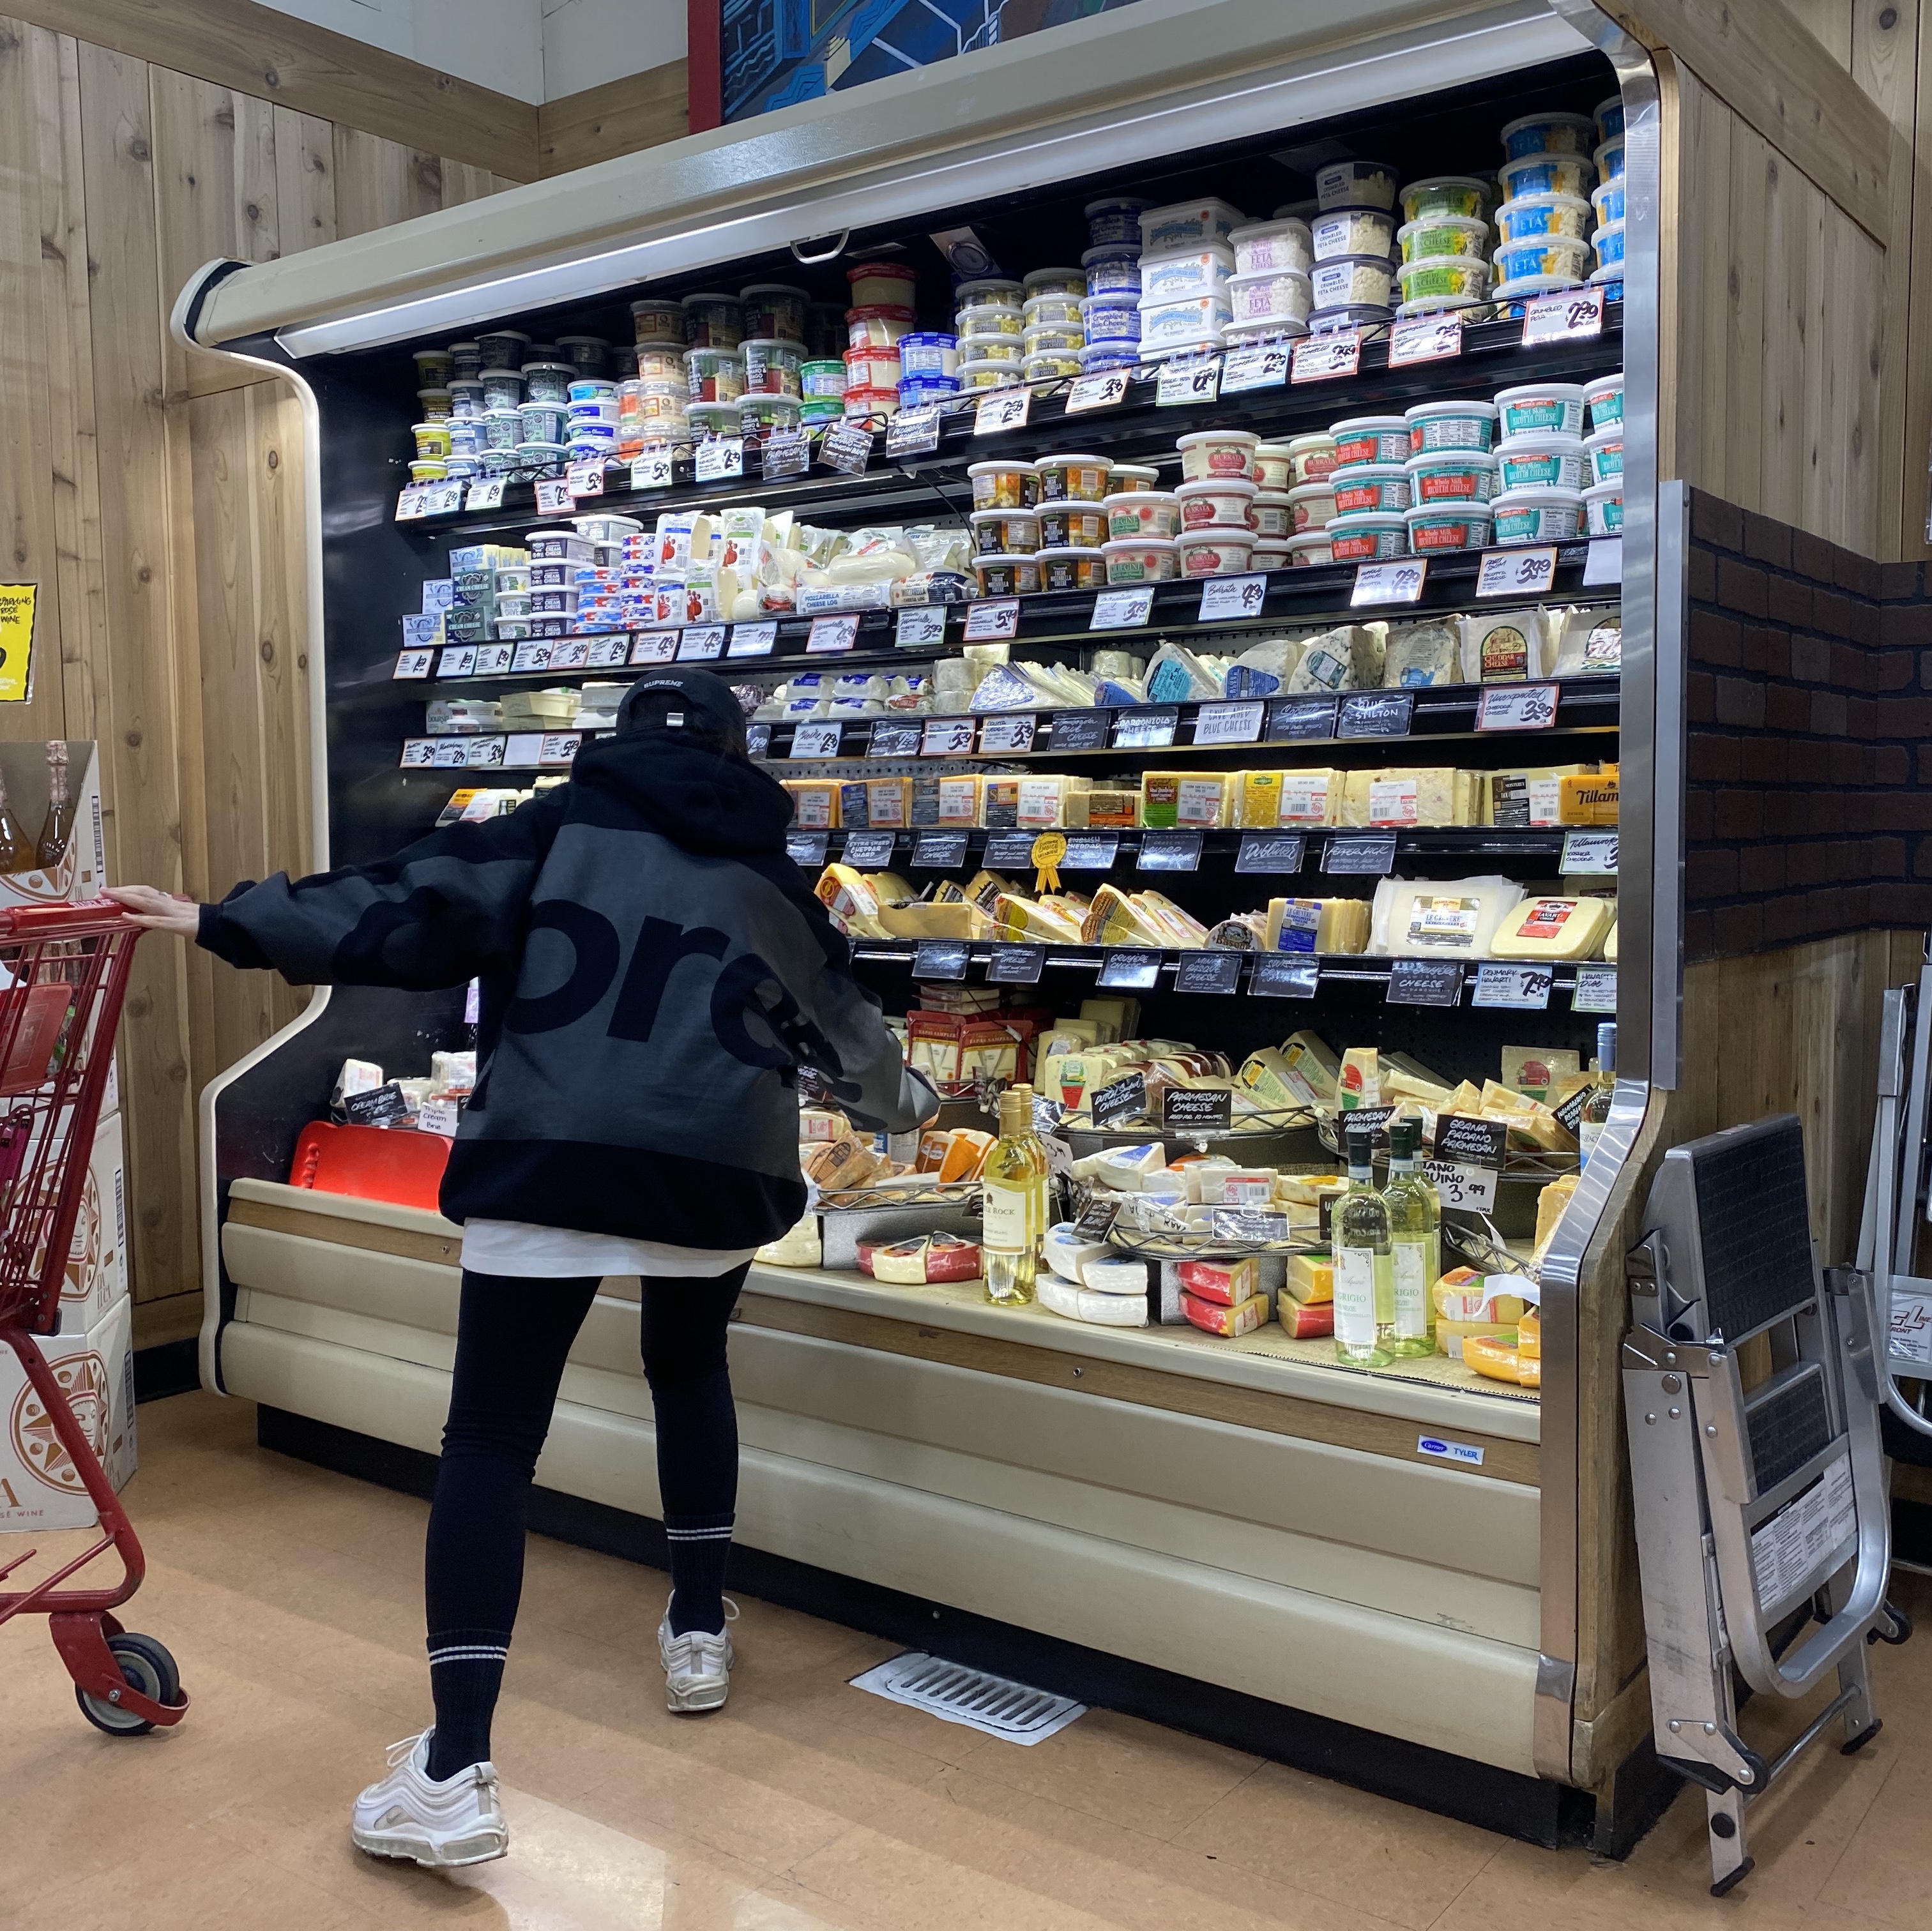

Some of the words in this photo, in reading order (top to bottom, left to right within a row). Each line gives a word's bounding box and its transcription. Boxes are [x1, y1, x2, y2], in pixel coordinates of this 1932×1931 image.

[1321, 191, 1331, 199] FETA
[1332, 186, 1349, 196] CHEESE
[1320, 231, 1342, 241] CRUMBLED
[1328, 236, 1346, 245] CHEESE
[1424, 237, 1451, 246] CHEESE
[1251, 253, 1272, 264] FETA
[1318, 287, 1328, 296] FETA
[1329, 283, 1348, 293] CHEESE
[1320, 279, 1344, 289] CRUMBLED
[1249, 298, 1270, 308] FETA
[1531, 305, 1562, 315] CRUMBLED
[1513, 416, 1533, 425] RICOTTA
[1535, 414, 1556, 423] CHEESE
[1352, 450, 1369, 458] CHEESE
[1509, 470, 1528, 479] RICOTTA
[1530, 468, 1551, 476] CHEESE
[1427, 483, 1447, 494] RICOTTA
[1449, 483, 1470, 492] CHEESE
[1355, 496, 1372, 505] CHEESE
[1419, 536, 1438, 544] RICOTTA
[1351, 545, 1369, 553] CHEESE
[1208, 584, 1237, 596] Burrata
[805, 594, 839, 602] MOZZARELLA
[1, 616, 20, 624] WINE
[1485, 654, 1515, 662] CHEDDAR
[644, 679, 683, 688] SUPREME
[1487, 688, 1547, 706] Unexpected
[1209, 708, 1226, 720] CAVE
[1230, 707, 1252, 717] AGED
[1355, 709, 1398, 720] STILTON
[1122, 726, 1157, 734] CHEESE
[1203, 722, 1221, 734] BLUE
[1224, 719, 1251, 731] CHEESE
[1577, 790, 1618, 805] Tillam
[920, 843, 958, 852] CHEDDAR
[1038, 844, 1058, 852] CHOICE
[1569, 838, 1618, 849] Tillamook
[1246, 842, 1295, 860] Dubliner
[1327, 846, 1360, 856] PEPPER
[1358, 845, 1389, 856] JACK
[1186, 964, 1221, 974] BASQUE
[1482, 969, 1518, 977] DENMARK
[1398, 980, 1445, 988] CHEESE
[351, 1100, 377, 1111] CREAM
[377, 1092, 397, 1105] BRIE
[1095, 1089, 1116, 1105] DUTCH
[1167, 1092, 1228, 1103] PARMESAN
[1172, 1103, 1213, 1112] CHEESE
[423, 1114, 446, 1122] Cream
[1344, 1110, 1390, 1123] PARMESAN
[1450, 1119, 1487, 1134] GRANA
[1447, 1129, 1491, 1143] PADANO
[1441, 1138, 1497, 1155] PARMESAN
[1338, 1292, 1366, 1303] GRIGIO
[1424, 1442, 1445, 1451] Carrier
[1454, 1448, 1479, 1460] TYLER
[17, 1509, 45, 1518] WINE
